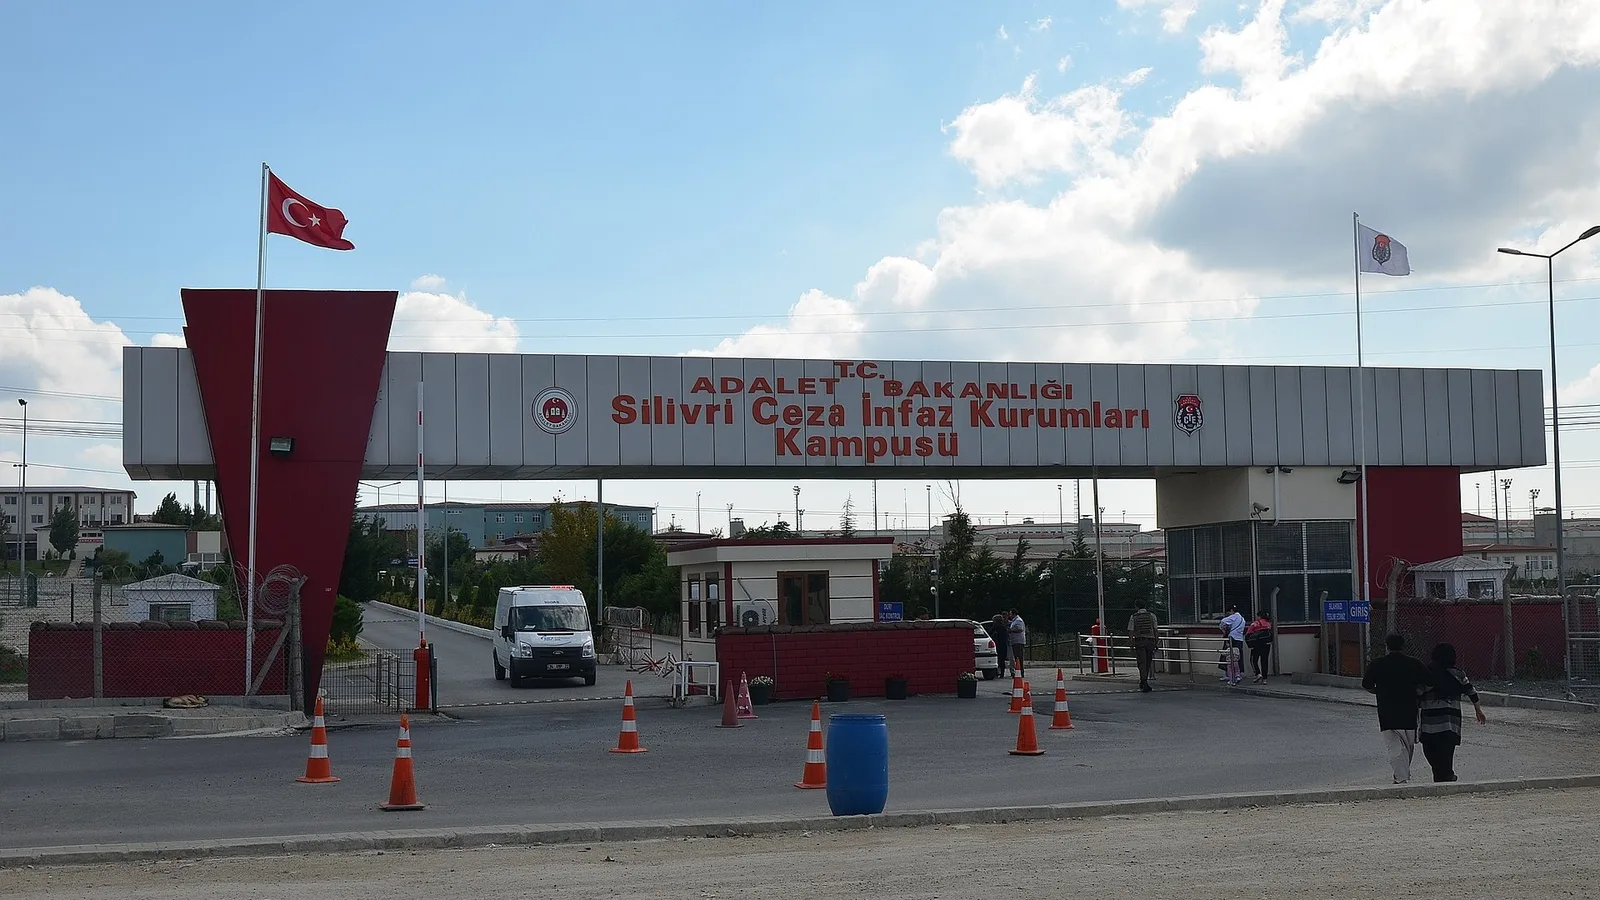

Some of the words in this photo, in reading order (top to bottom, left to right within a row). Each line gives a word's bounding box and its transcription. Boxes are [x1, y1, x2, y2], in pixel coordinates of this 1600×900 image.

[834, 361, 885, 379] T.C.
[690, 377, 840, 394] ADALET
[883, 379, 1073, 400] BAKANLIĞI
[611, 394, 733, 425] Silivri
[752, 396, 845, 426] Ceza
[862, 392, 953, 427] İnfaz
[969, 400, 1150, 428] Kurumları
[775, 427, 959, 463] Kampusü
